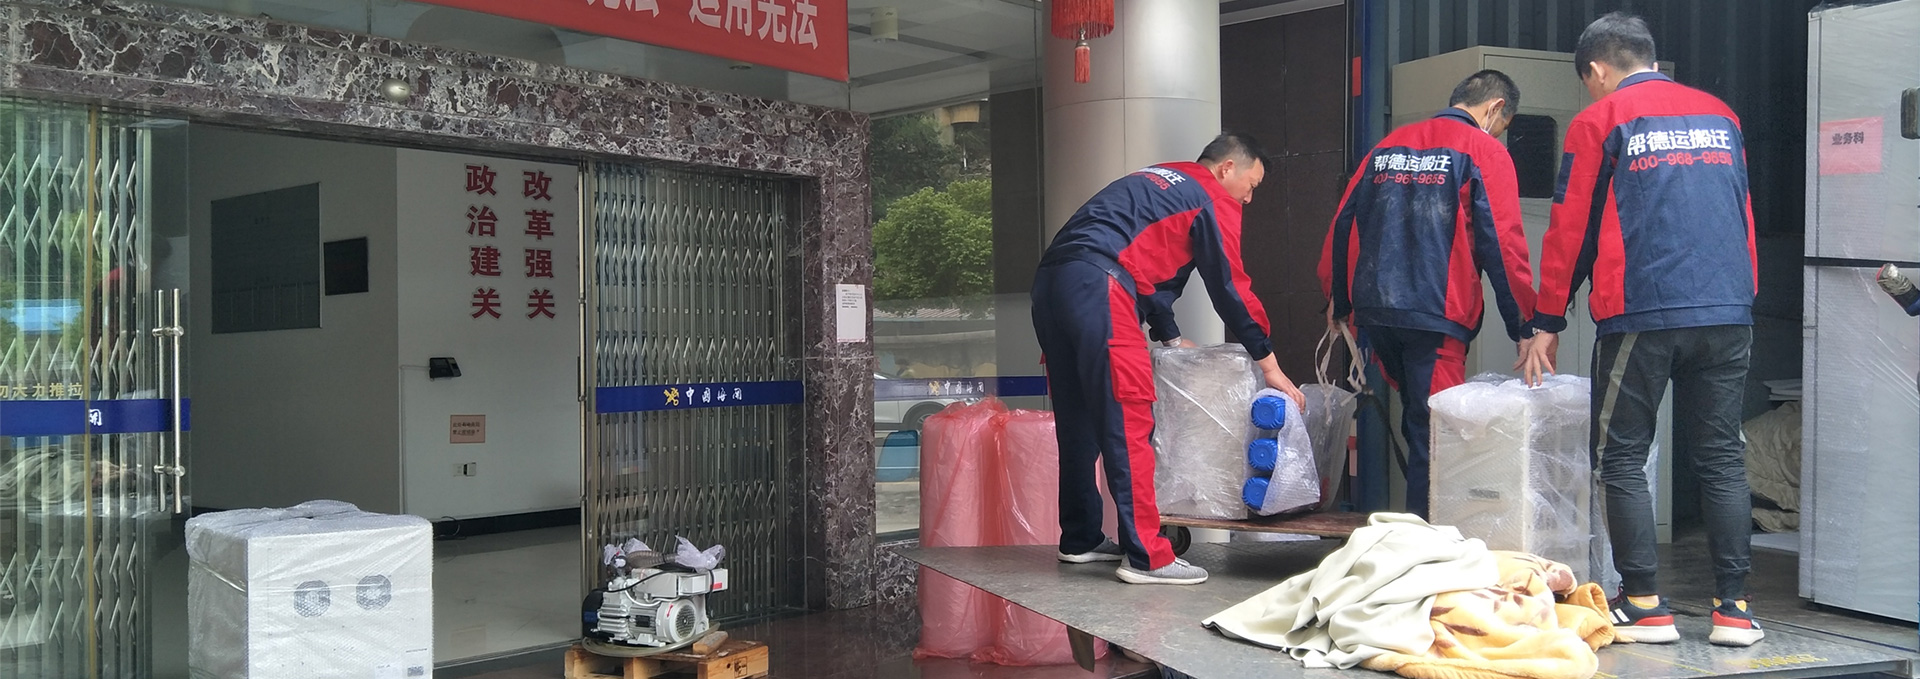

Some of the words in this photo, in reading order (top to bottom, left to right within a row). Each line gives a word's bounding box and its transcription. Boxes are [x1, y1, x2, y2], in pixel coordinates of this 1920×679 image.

[1626, 129, 1731, 156] 帮德运搬迁
[1374, 153, 1452, 172] 帮德运搬迁
[1373, 172, 1447, 185] 400-96-9655
[466, 164, 502, 319] 政治建关
[523, 170, 556, 319] 改革强关
